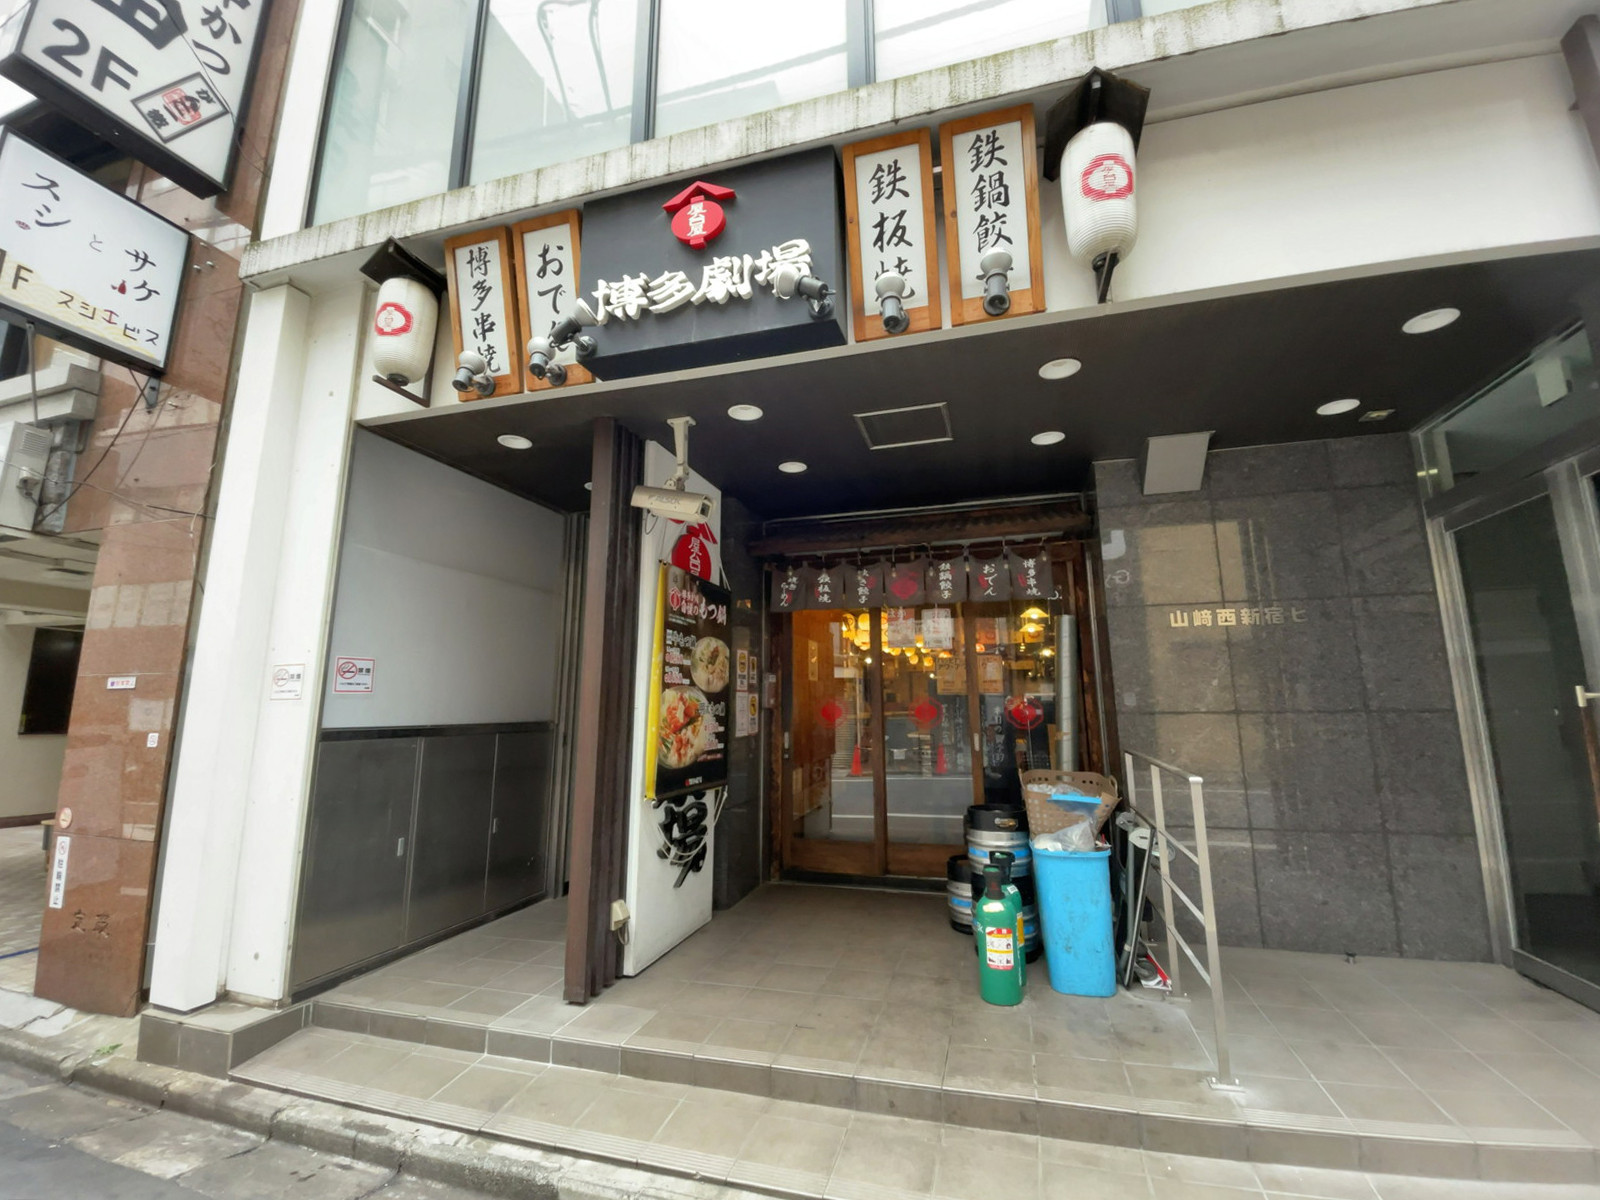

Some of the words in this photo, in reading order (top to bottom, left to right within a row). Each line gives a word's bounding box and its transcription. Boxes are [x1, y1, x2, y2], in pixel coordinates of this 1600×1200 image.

[41, 18, 138, 92] 2F
[192, 0, 252, 75] かつ
[967, 129, 1013, 281] 鉄鍋餃
[58, 290, 159, 346] スシエビス
[591, 238, 814, 327] 博多劇場
[688, 537, 702, 575] 屋台
[982, 563, 998, 597] おでん
